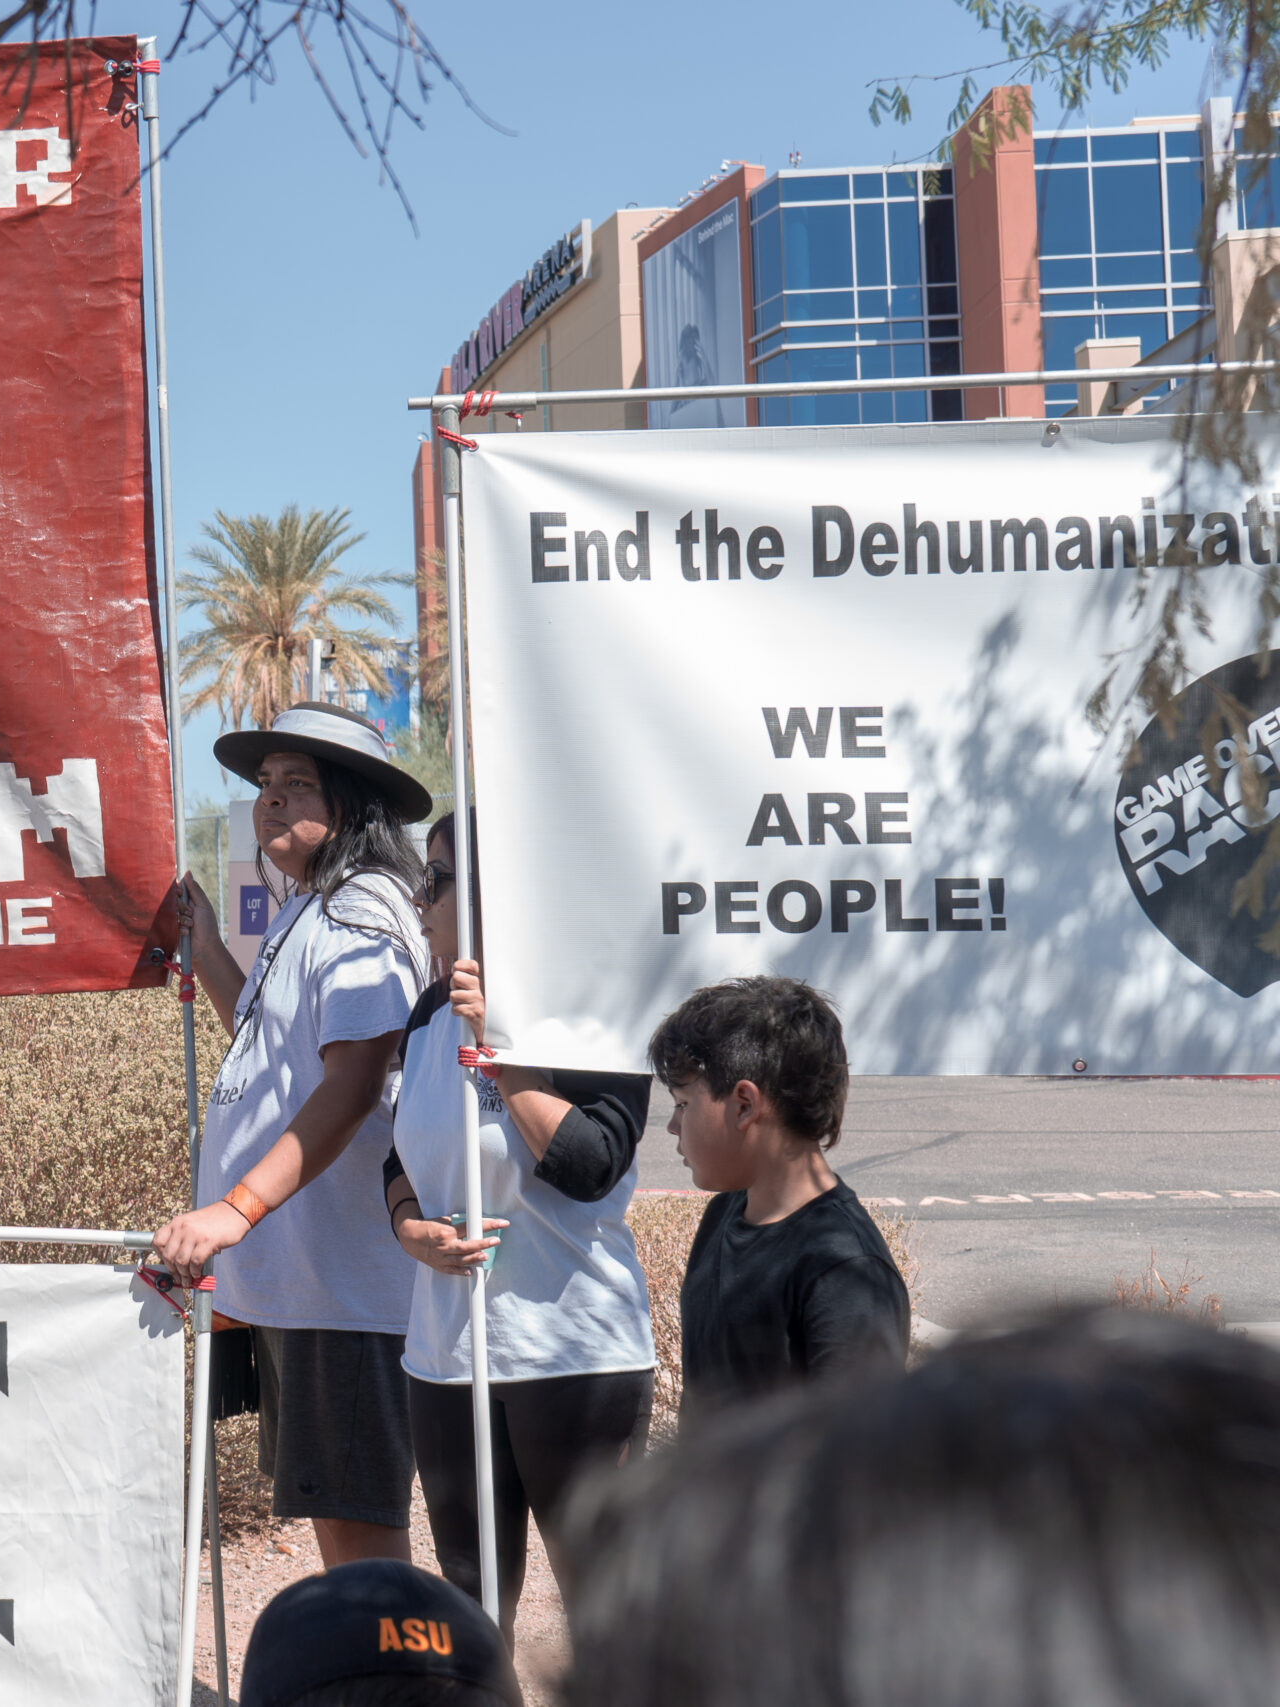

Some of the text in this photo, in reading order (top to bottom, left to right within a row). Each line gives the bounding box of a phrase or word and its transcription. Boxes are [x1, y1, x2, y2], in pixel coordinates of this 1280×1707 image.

[479, 280, 525, 373] RIVER
[523, 233, 575, 303] ARENA
[530, 510, 652, 583] End
[675, 508, 786, 582] the
[761, 706, 886, 759] WE
[1116, 706, 1280, 827] GAME OVE
[745, 792, 912, 847] ARE
[247, 898, 261, 909] LOT
[251, 912, 257, 922] F
[661, 878, 1007, 934] PEOPLE!
[379, 1618, 452, 1656] ASU
